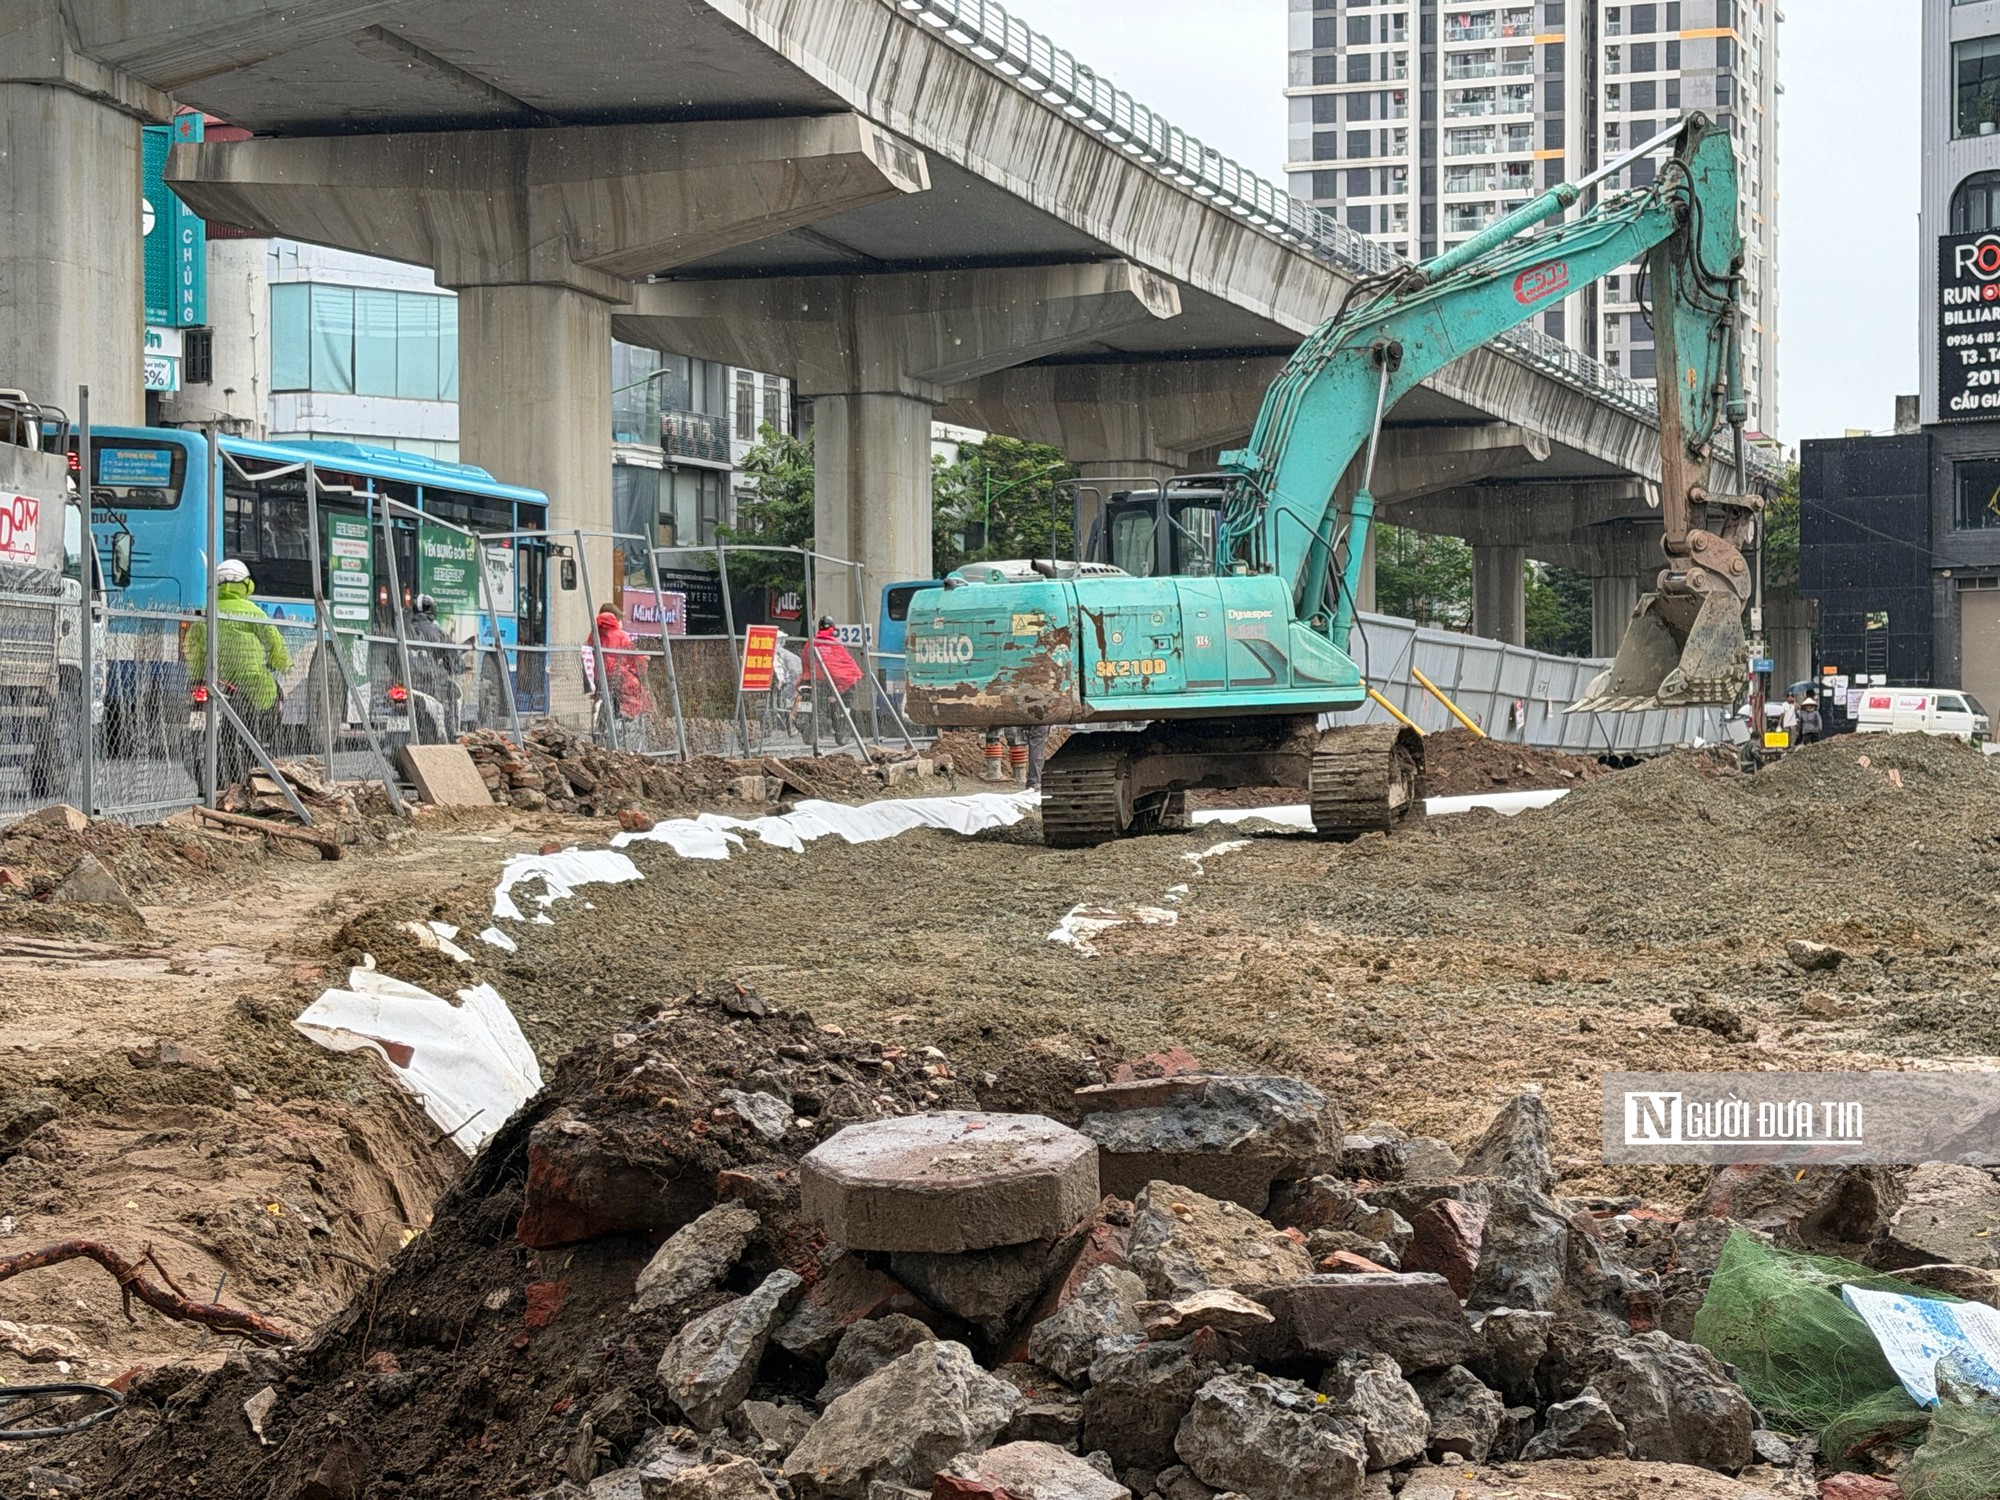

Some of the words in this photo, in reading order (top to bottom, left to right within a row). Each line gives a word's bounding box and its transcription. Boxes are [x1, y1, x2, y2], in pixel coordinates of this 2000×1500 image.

[1943, 285, 1980, 306] RUN
[1946, 332, 1974, 347] 0936
[1976, 331, 1995, 345] 418
[1960, 350, 1978, 365] T3
[1228, 608, 1274, 621] Dynaspec
[1095, 658, 1167, 677] SK210D
